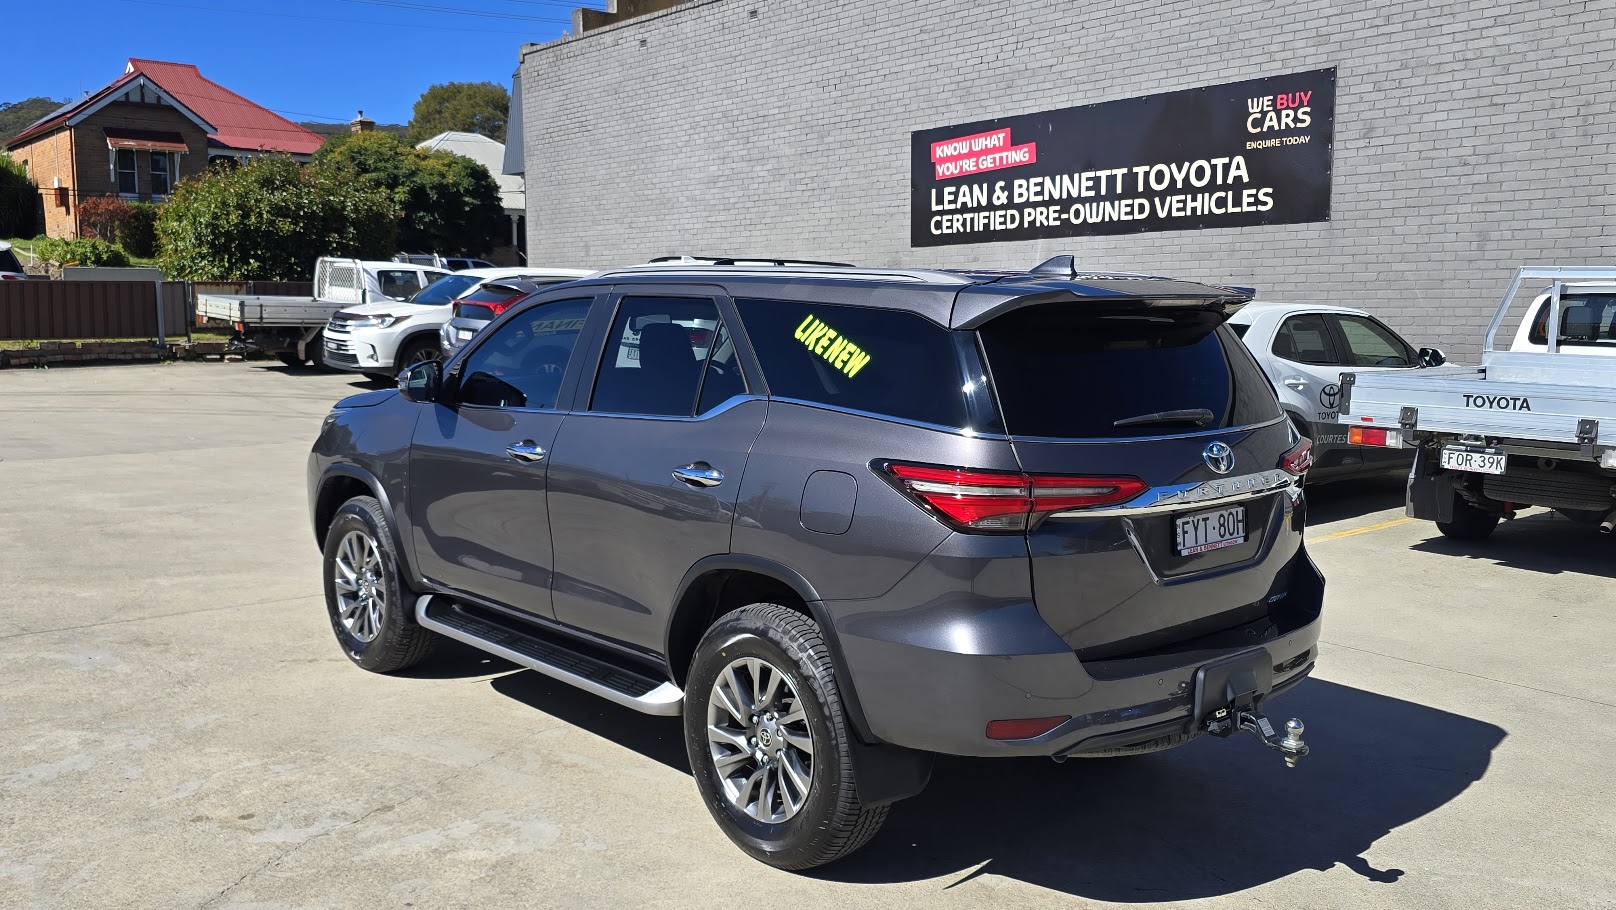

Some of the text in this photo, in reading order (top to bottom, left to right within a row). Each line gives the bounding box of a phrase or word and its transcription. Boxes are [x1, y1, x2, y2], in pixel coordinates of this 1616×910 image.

[1247, 90, 1312, 113] WE BUY
[1246, 107, 1312, 133] CARS
[936, 133, 1005, 158] KNOW WHAT
[1246, 135, 1311, 150] ENQUIRE TODAY
[936, 148, 1029, 176] YOU'RE GETTING
[931, 155, 1250, 211] LEAN & BENNETT TOYOTA
[930, 187, 1274, 235] CERTIFIED PRE-OWNED VEHICLES
[794, 314, 871, 378] LIKE NEW
[1463, 394, 1531, 411] TOYOTA
[1317, 411, 1339, 421] TOYOT
[1316, 434, 1347, 445] COURTES
